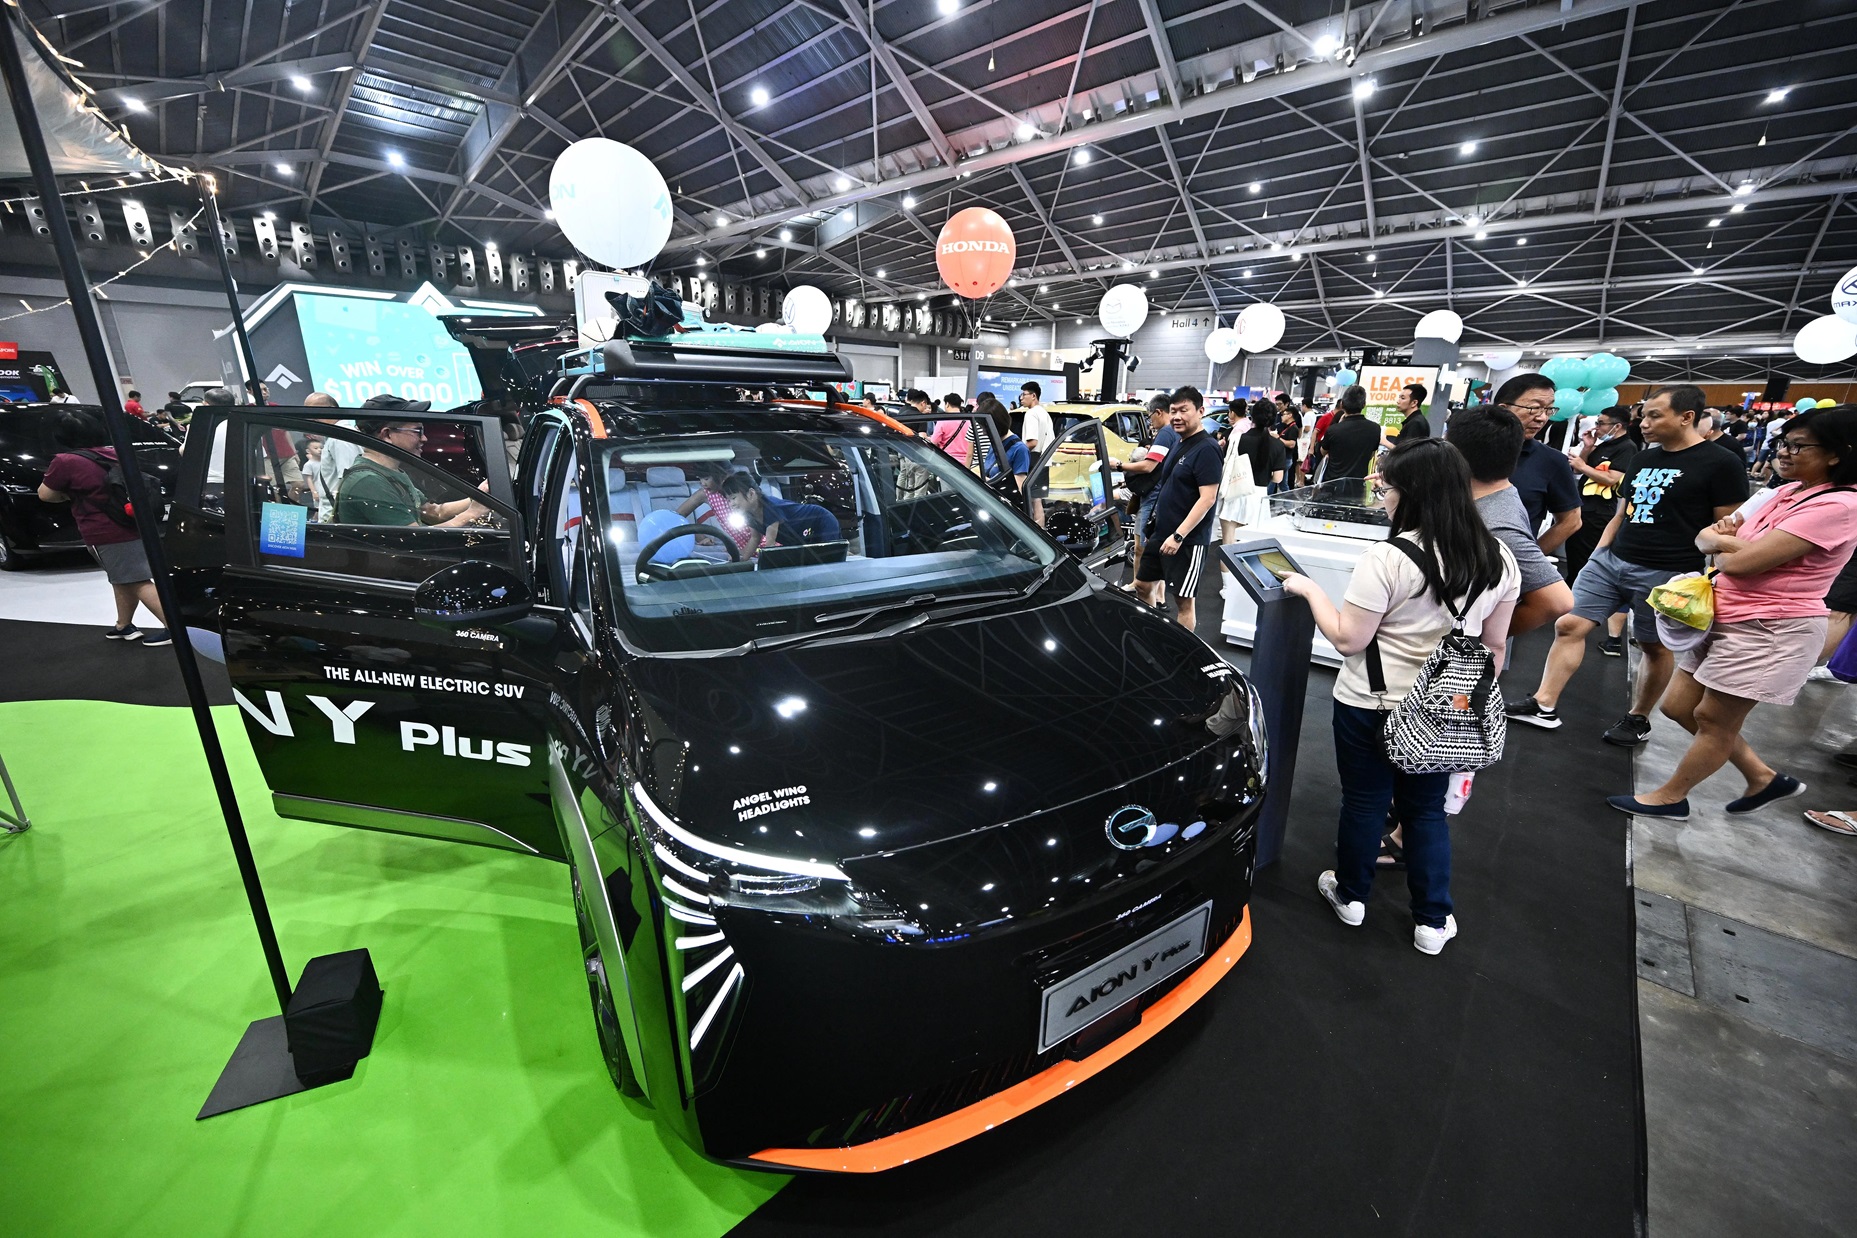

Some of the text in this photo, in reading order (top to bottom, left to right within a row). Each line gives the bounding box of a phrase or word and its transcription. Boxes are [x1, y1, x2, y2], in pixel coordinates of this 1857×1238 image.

[942, 240, 1010, 255] HONDA
[1171, 318, 1198, 328] Hall 4
[975, 350, 985, 360] D9
[339, 360, 425, 379] WIN OVER
[1369, 392, 1397, 401] YOUR
[1631, 468, 1682, 487] JUST
[1632, 486, 1661, 505] DO
[1629, 503, 1655, 524] IT
[455, 630, 500, 642] 360 CAMERA
[323, 666, 525, 699] THE ALL-NEW ELECTRIC SUV
[305, 694, 376, 745] Y
[400, 720, 532, 767] Plus
[732, 785, 807, 811] ANGEL WING
[737, 795, 811, 822] HEADLIGHTS
[1115, 893, 1162, 921] 360 CAMERA
[1065, 939, 1192, 1018] AION Y Plus
